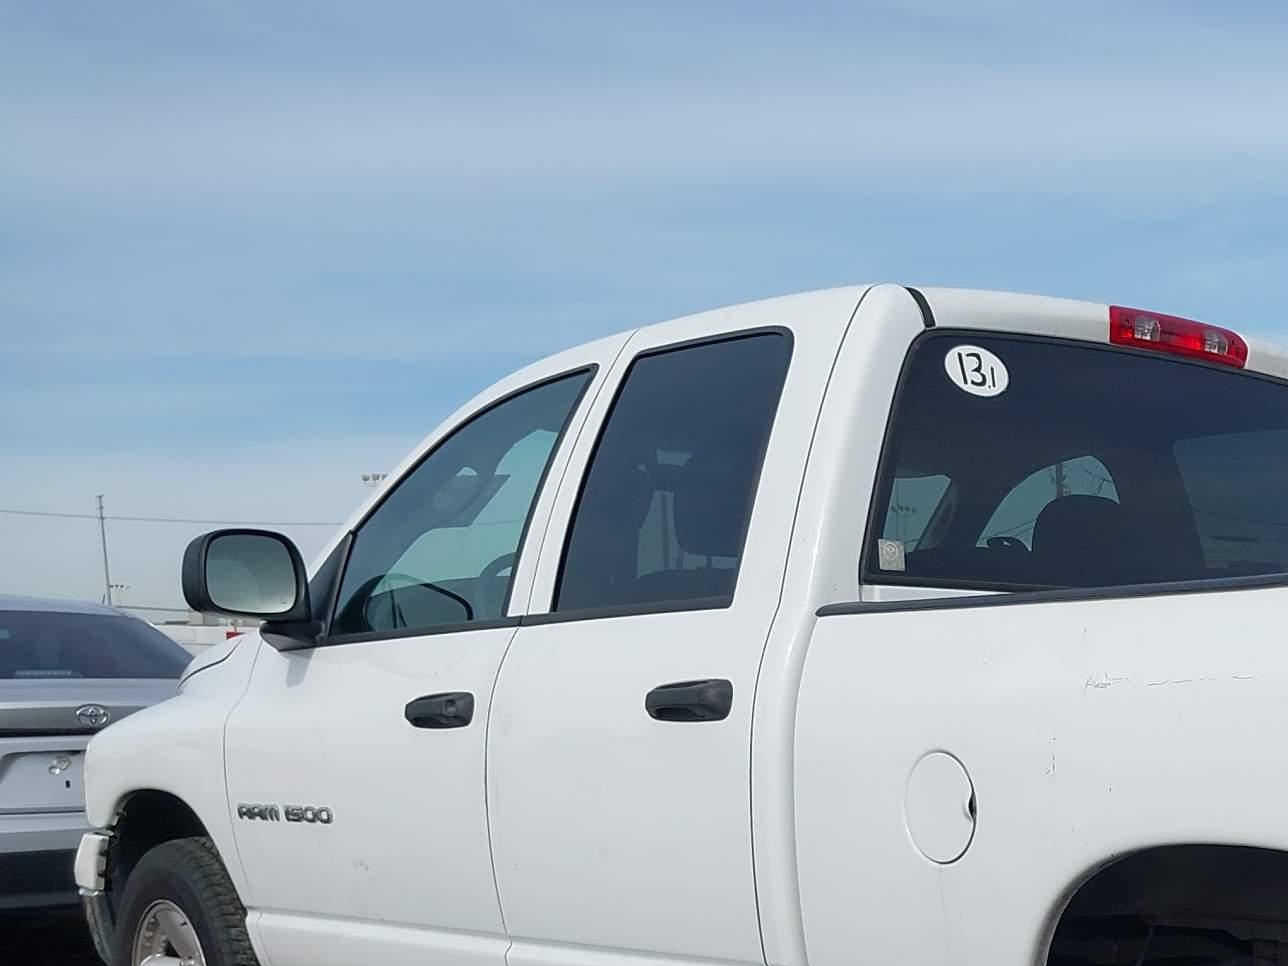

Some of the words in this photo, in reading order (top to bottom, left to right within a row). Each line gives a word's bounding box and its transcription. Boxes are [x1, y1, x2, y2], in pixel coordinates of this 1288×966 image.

[957, 352, 996, 389] 13.1
[237, 802, 280, 822] RAM
[283, 804, 334, 825] 1500
